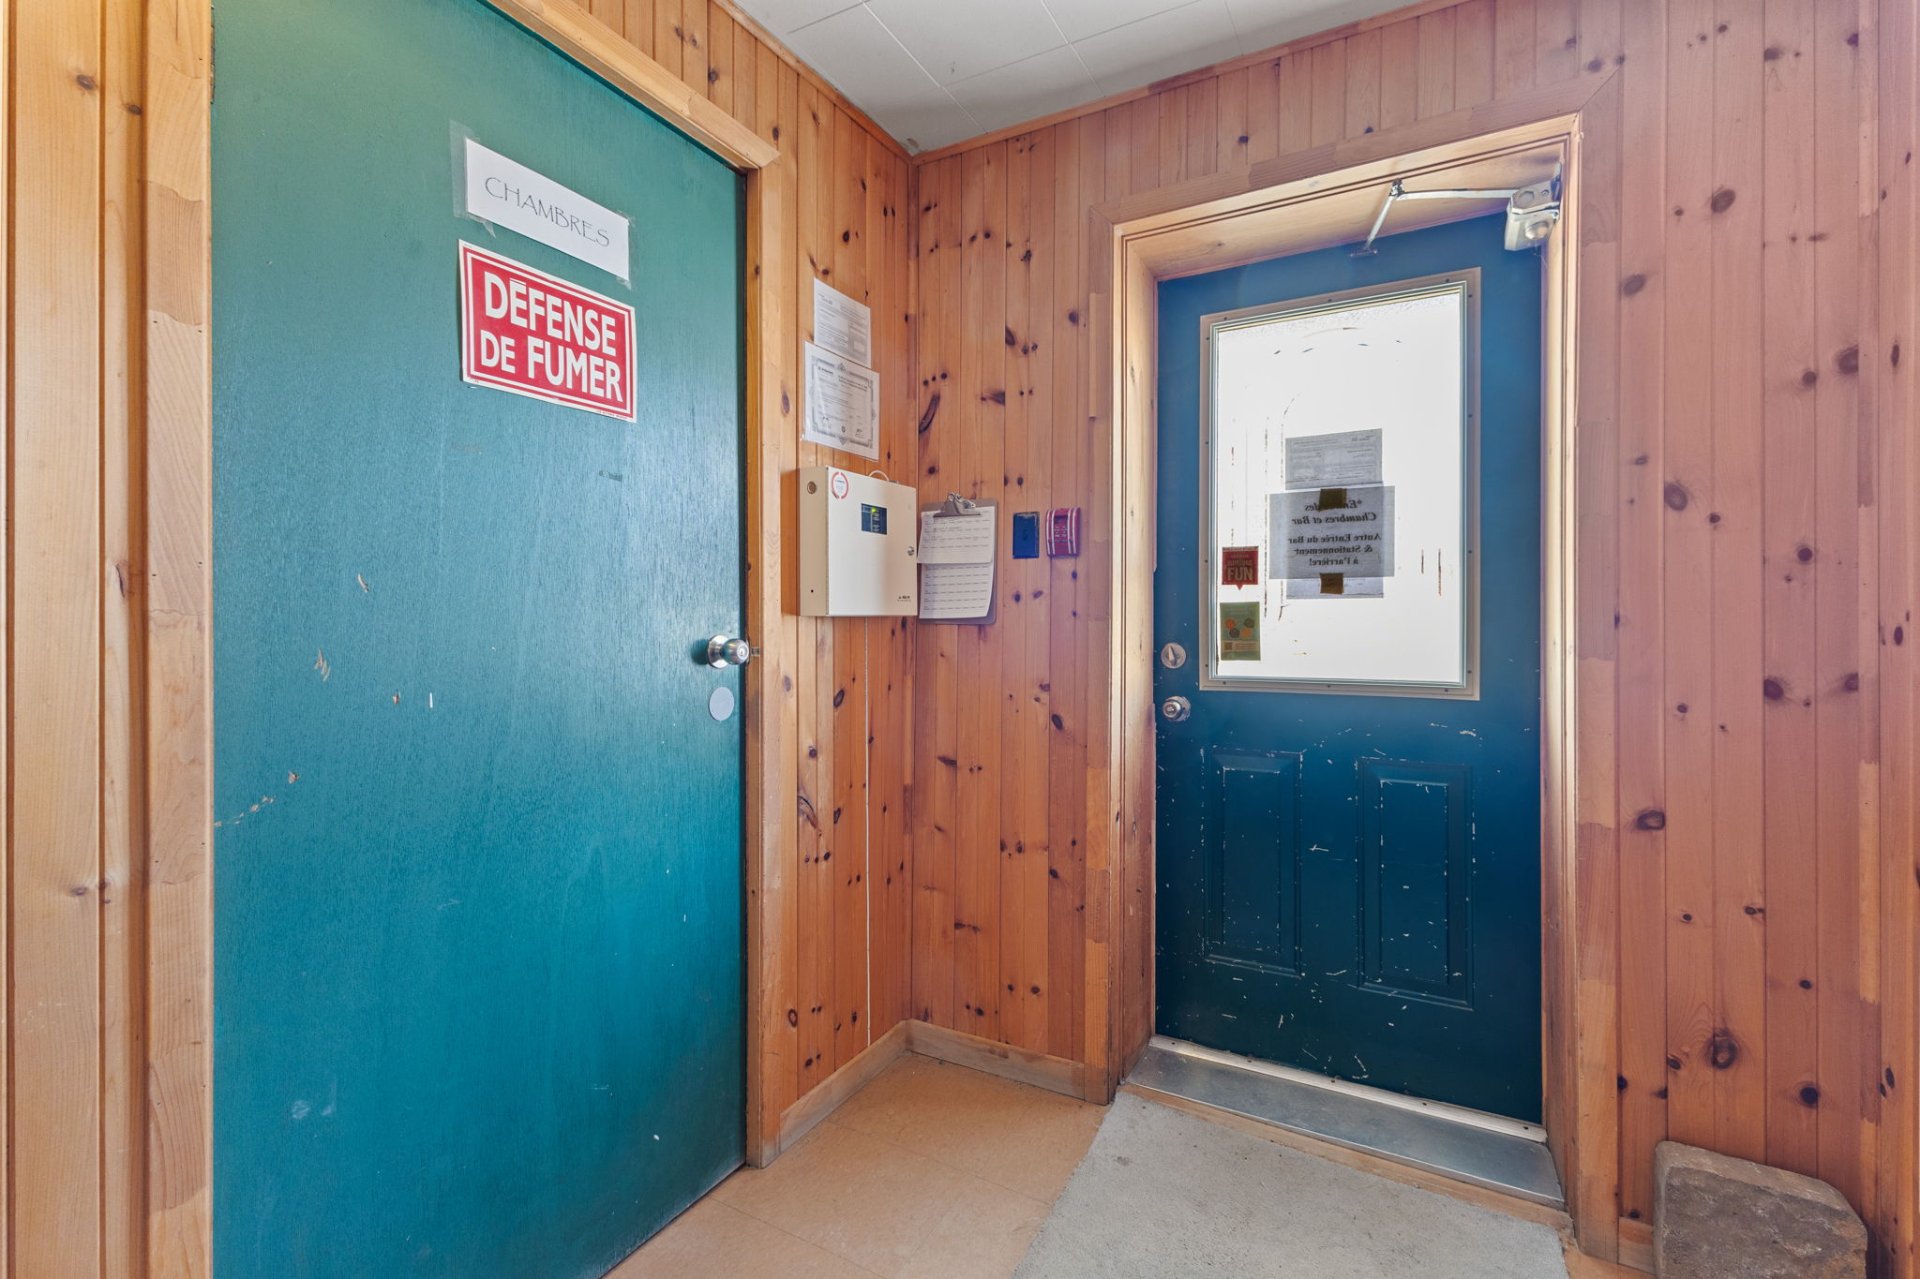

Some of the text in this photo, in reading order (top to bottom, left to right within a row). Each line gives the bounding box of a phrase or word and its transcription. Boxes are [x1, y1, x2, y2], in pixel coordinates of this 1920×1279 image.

[484, 176, 610, 248] CHAMBRES
[483, 270, 617, 357] DÉFENSE
[480, 329, 624, 403] DE FUMER
[1227, 567, 1253, 581] FUN
